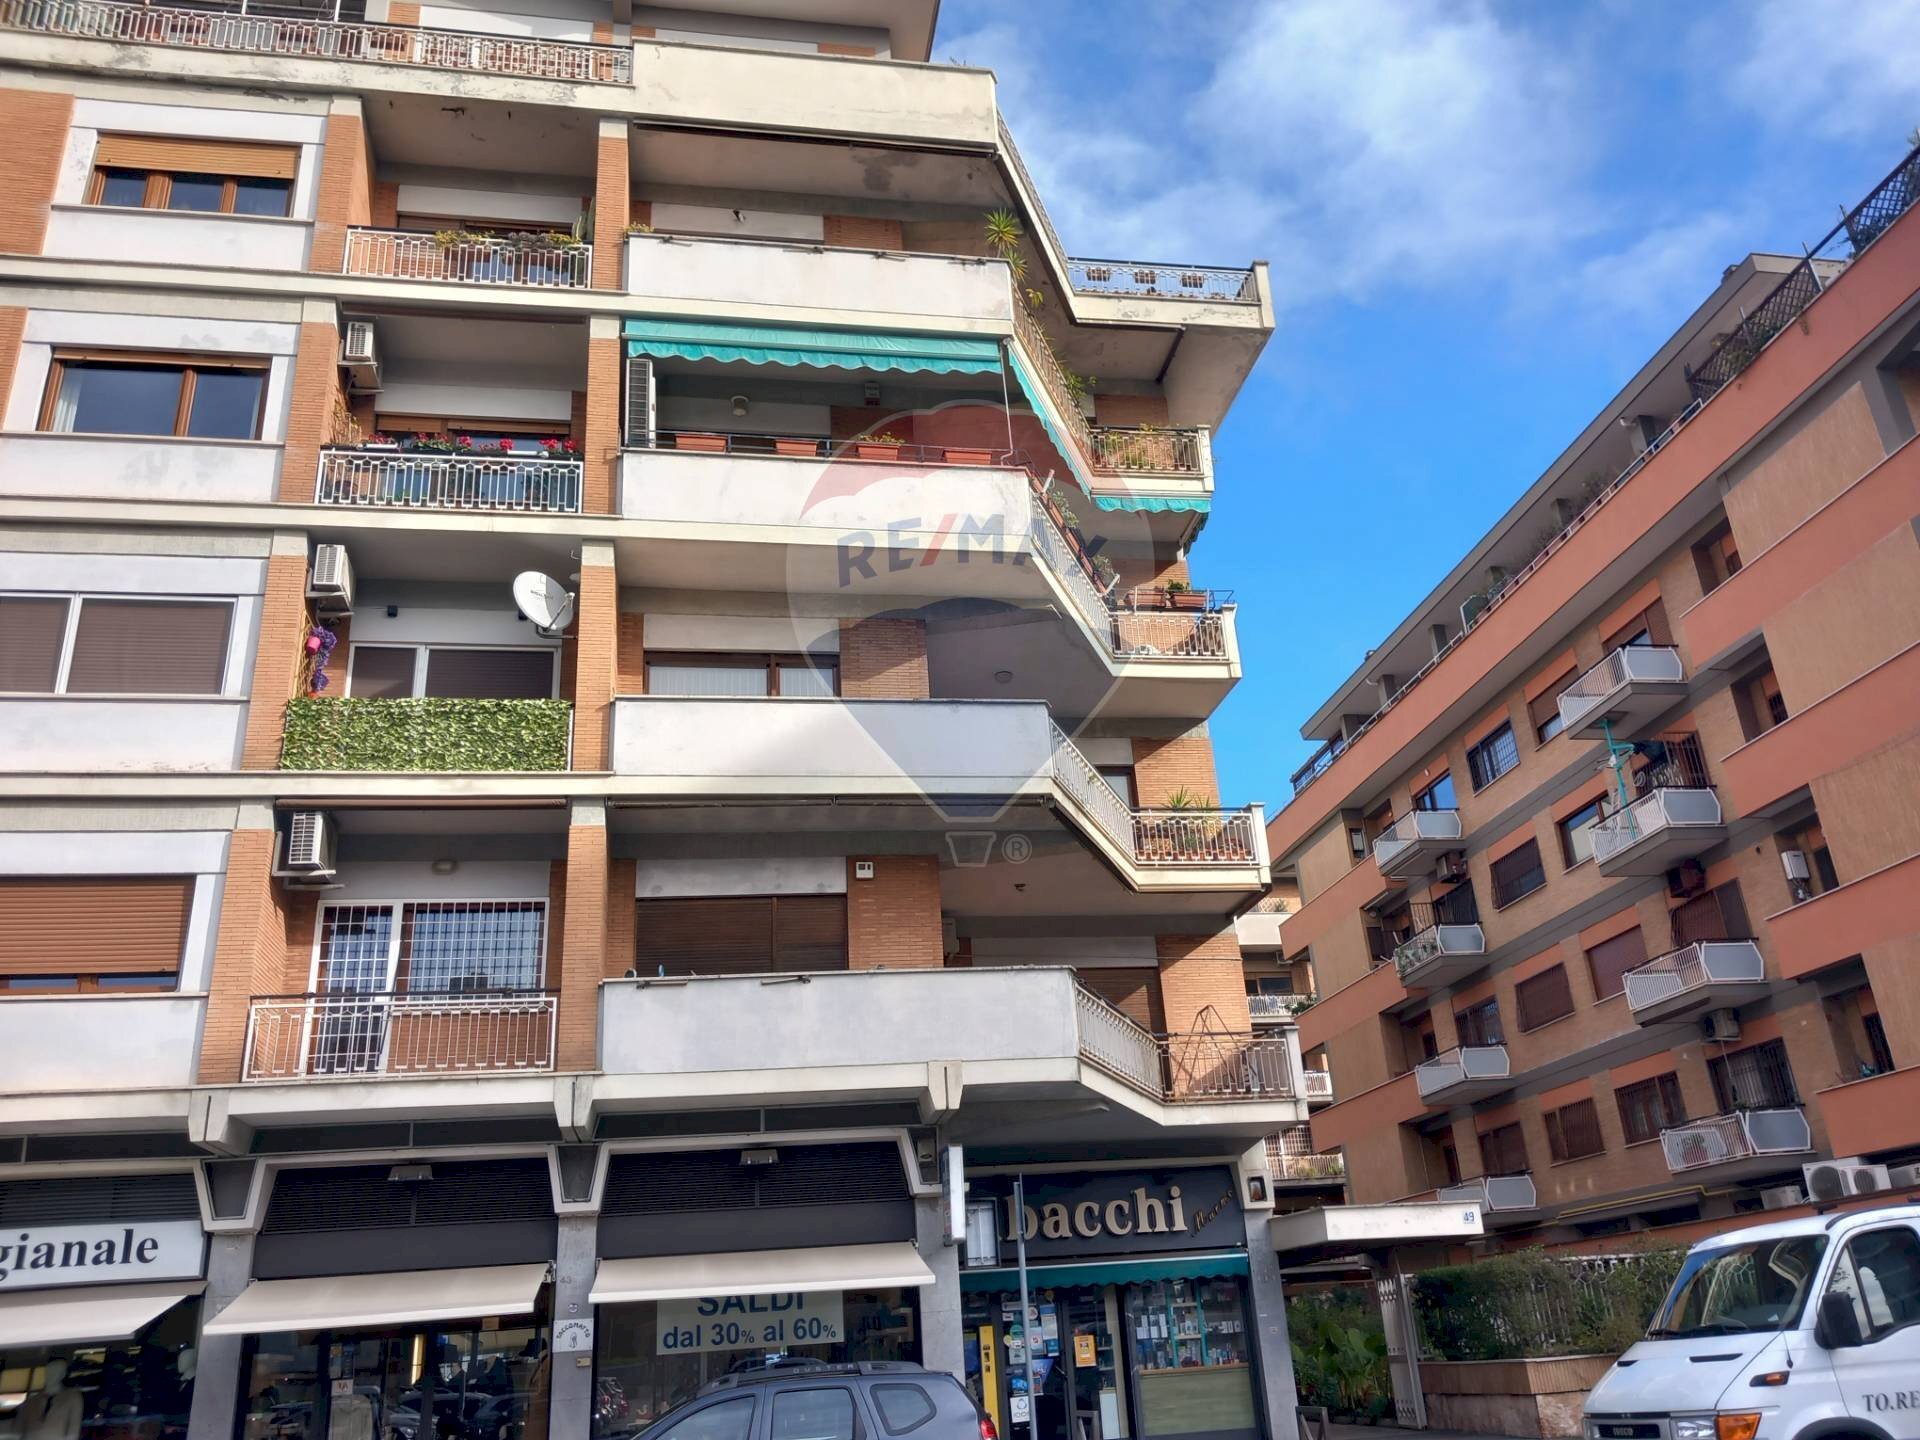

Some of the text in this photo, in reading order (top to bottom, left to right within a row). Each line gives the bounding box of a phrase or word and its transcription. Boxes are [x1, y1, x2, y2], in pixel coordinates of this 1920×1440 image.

[999, 1186, 1188, 1241] bacchi
[663, 1317, 837, 1349] dal 30% al 60%
